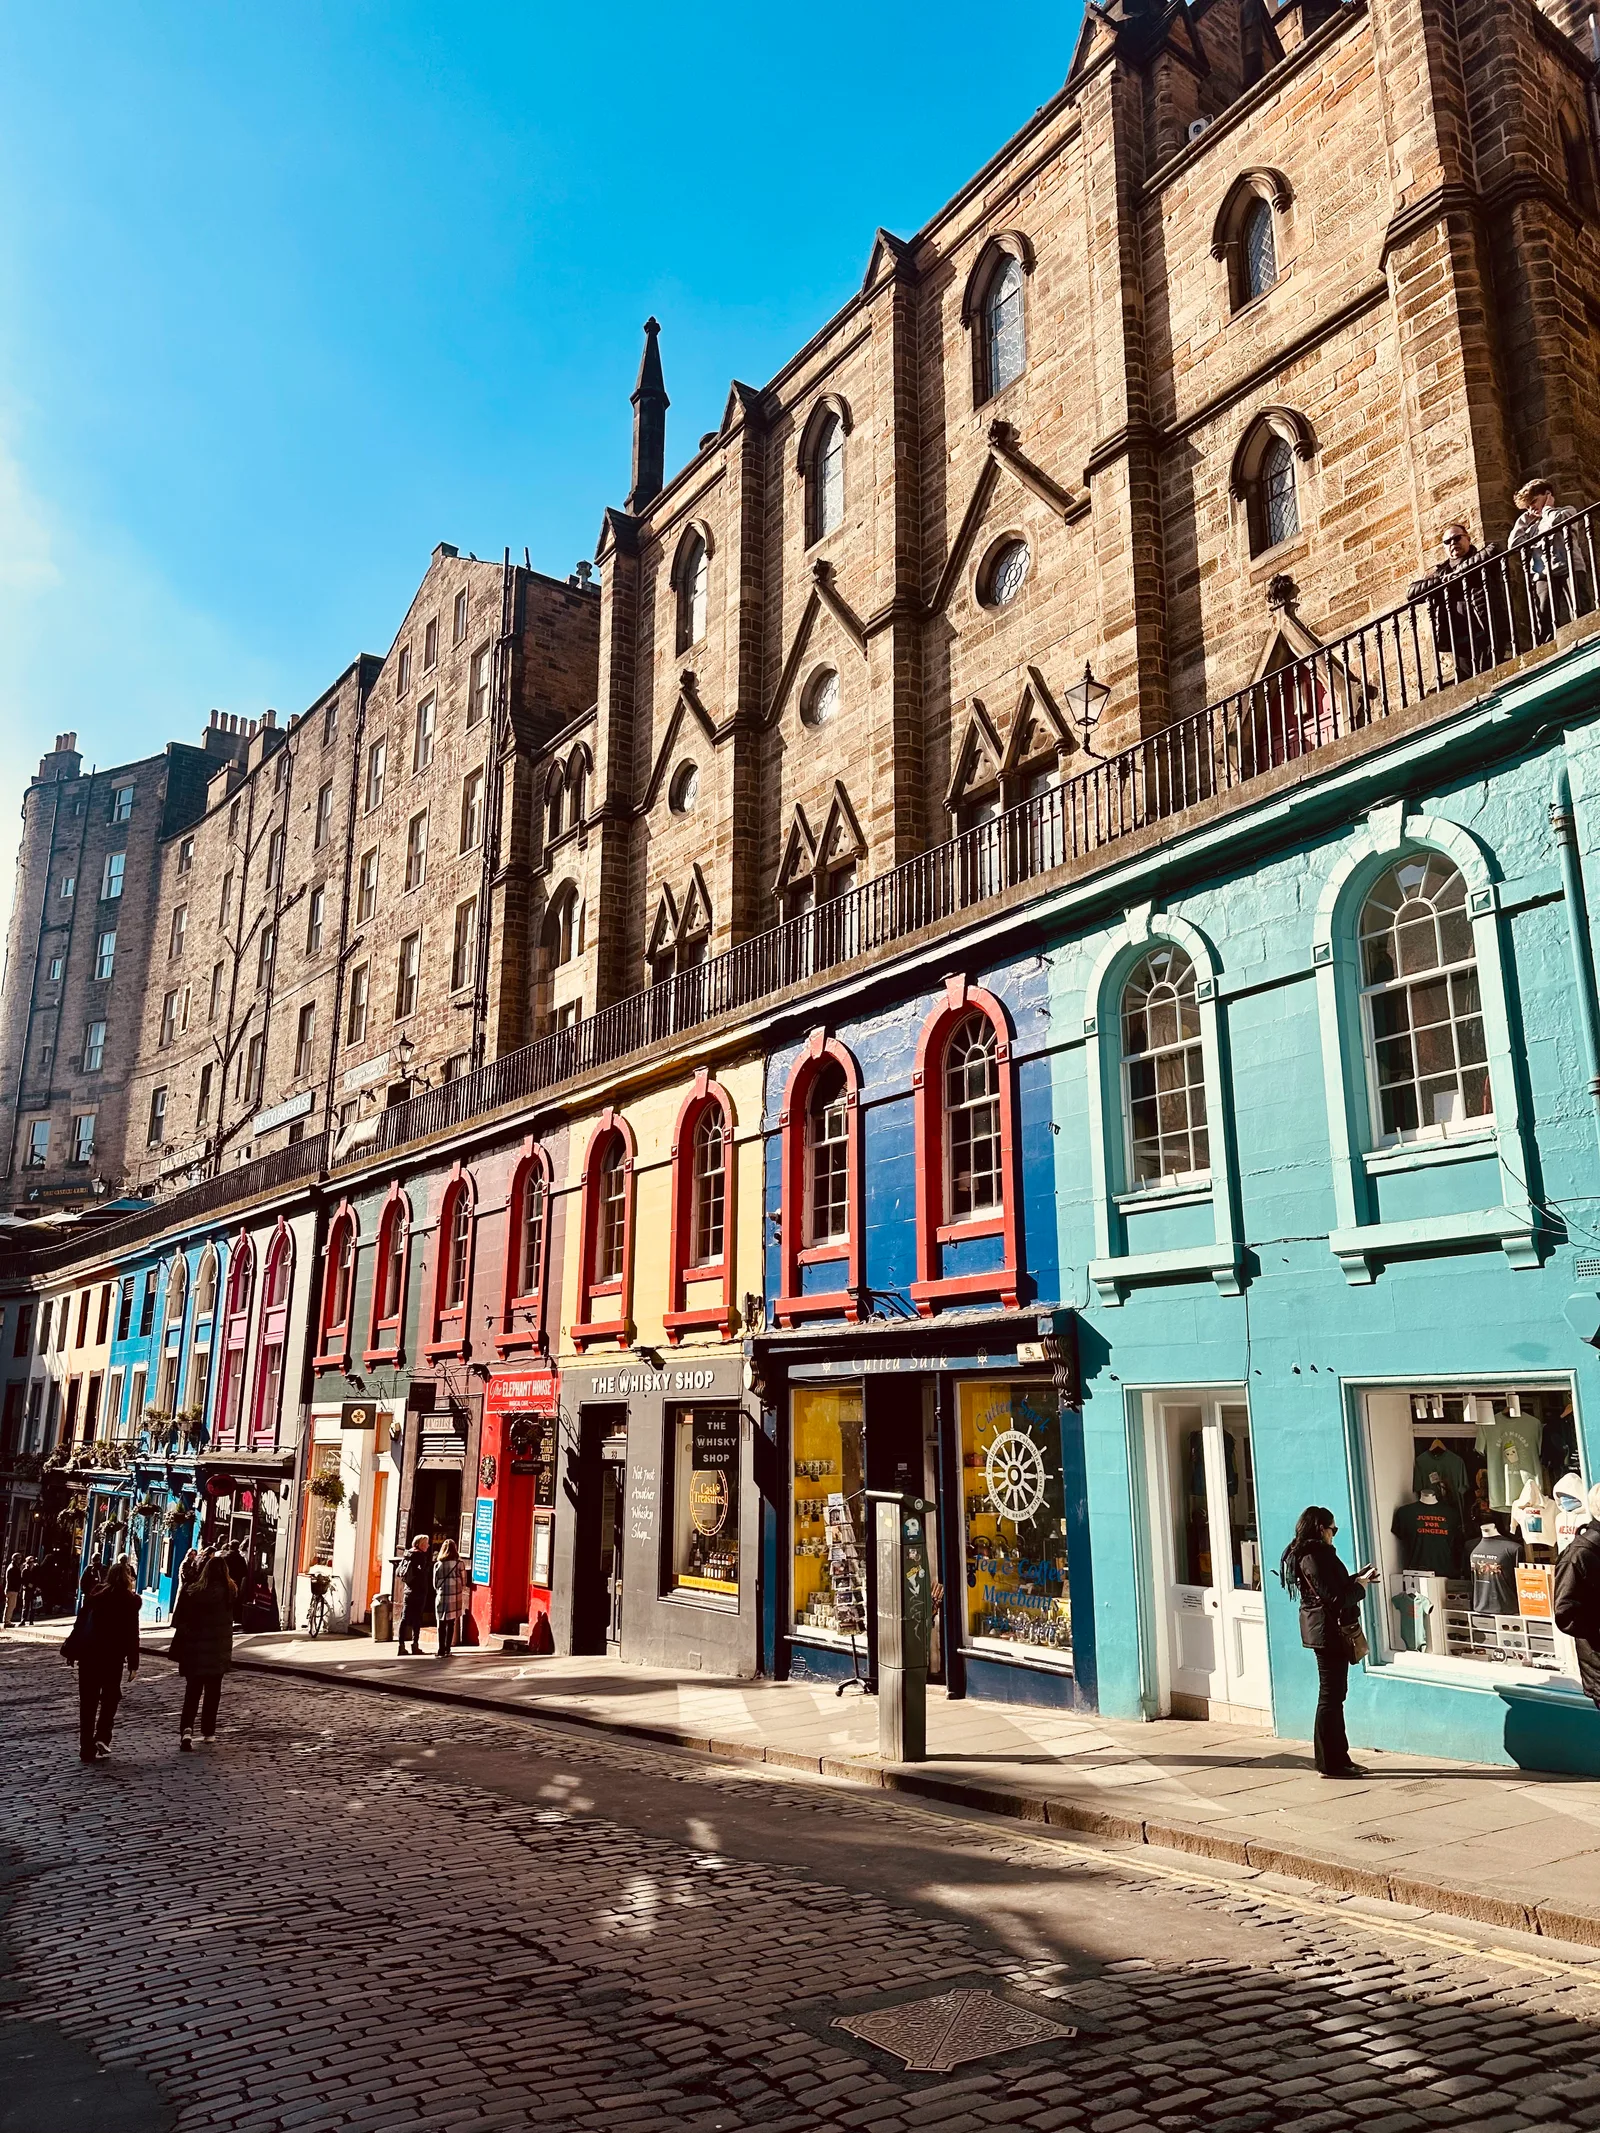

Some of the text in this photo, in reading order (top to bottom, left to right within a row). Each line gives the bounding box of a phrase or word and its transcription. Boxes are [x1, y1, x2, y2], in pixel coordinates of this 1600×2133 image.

[910, 1348, 948, 1369] Sark
[502, 1381, 532, 1398] ELEPHANT
[532, 1380, 552, 1396] HOUSE
[592, 1370, 714, 1394] THE WHISKY SHOP
[1018, 1400, 1050, 1433] Sark
[706, 1422, 726, 1430] THE
[696, 1438, 737, 1446] WHISKY
[702, 1454, 730, 1462] SHOP
[632, 1465, 642, 1480] Not
[632, 1486, 656, 1500] Another
[700, 1482, 717, 1496] Cask
[694, 1492, 724, 1504] Treasures
[631, 1504, 654, 1527] Whisky
[1416, 1528, 1448, 1536] GINGERS
[974, 1554, 996, 1574] Tea
[1018, 1558, 1064, 1585] Coffee
[982, 1584, 1060, 1612] Merchants
[1520, 1590, 1546, 1600] Squish
